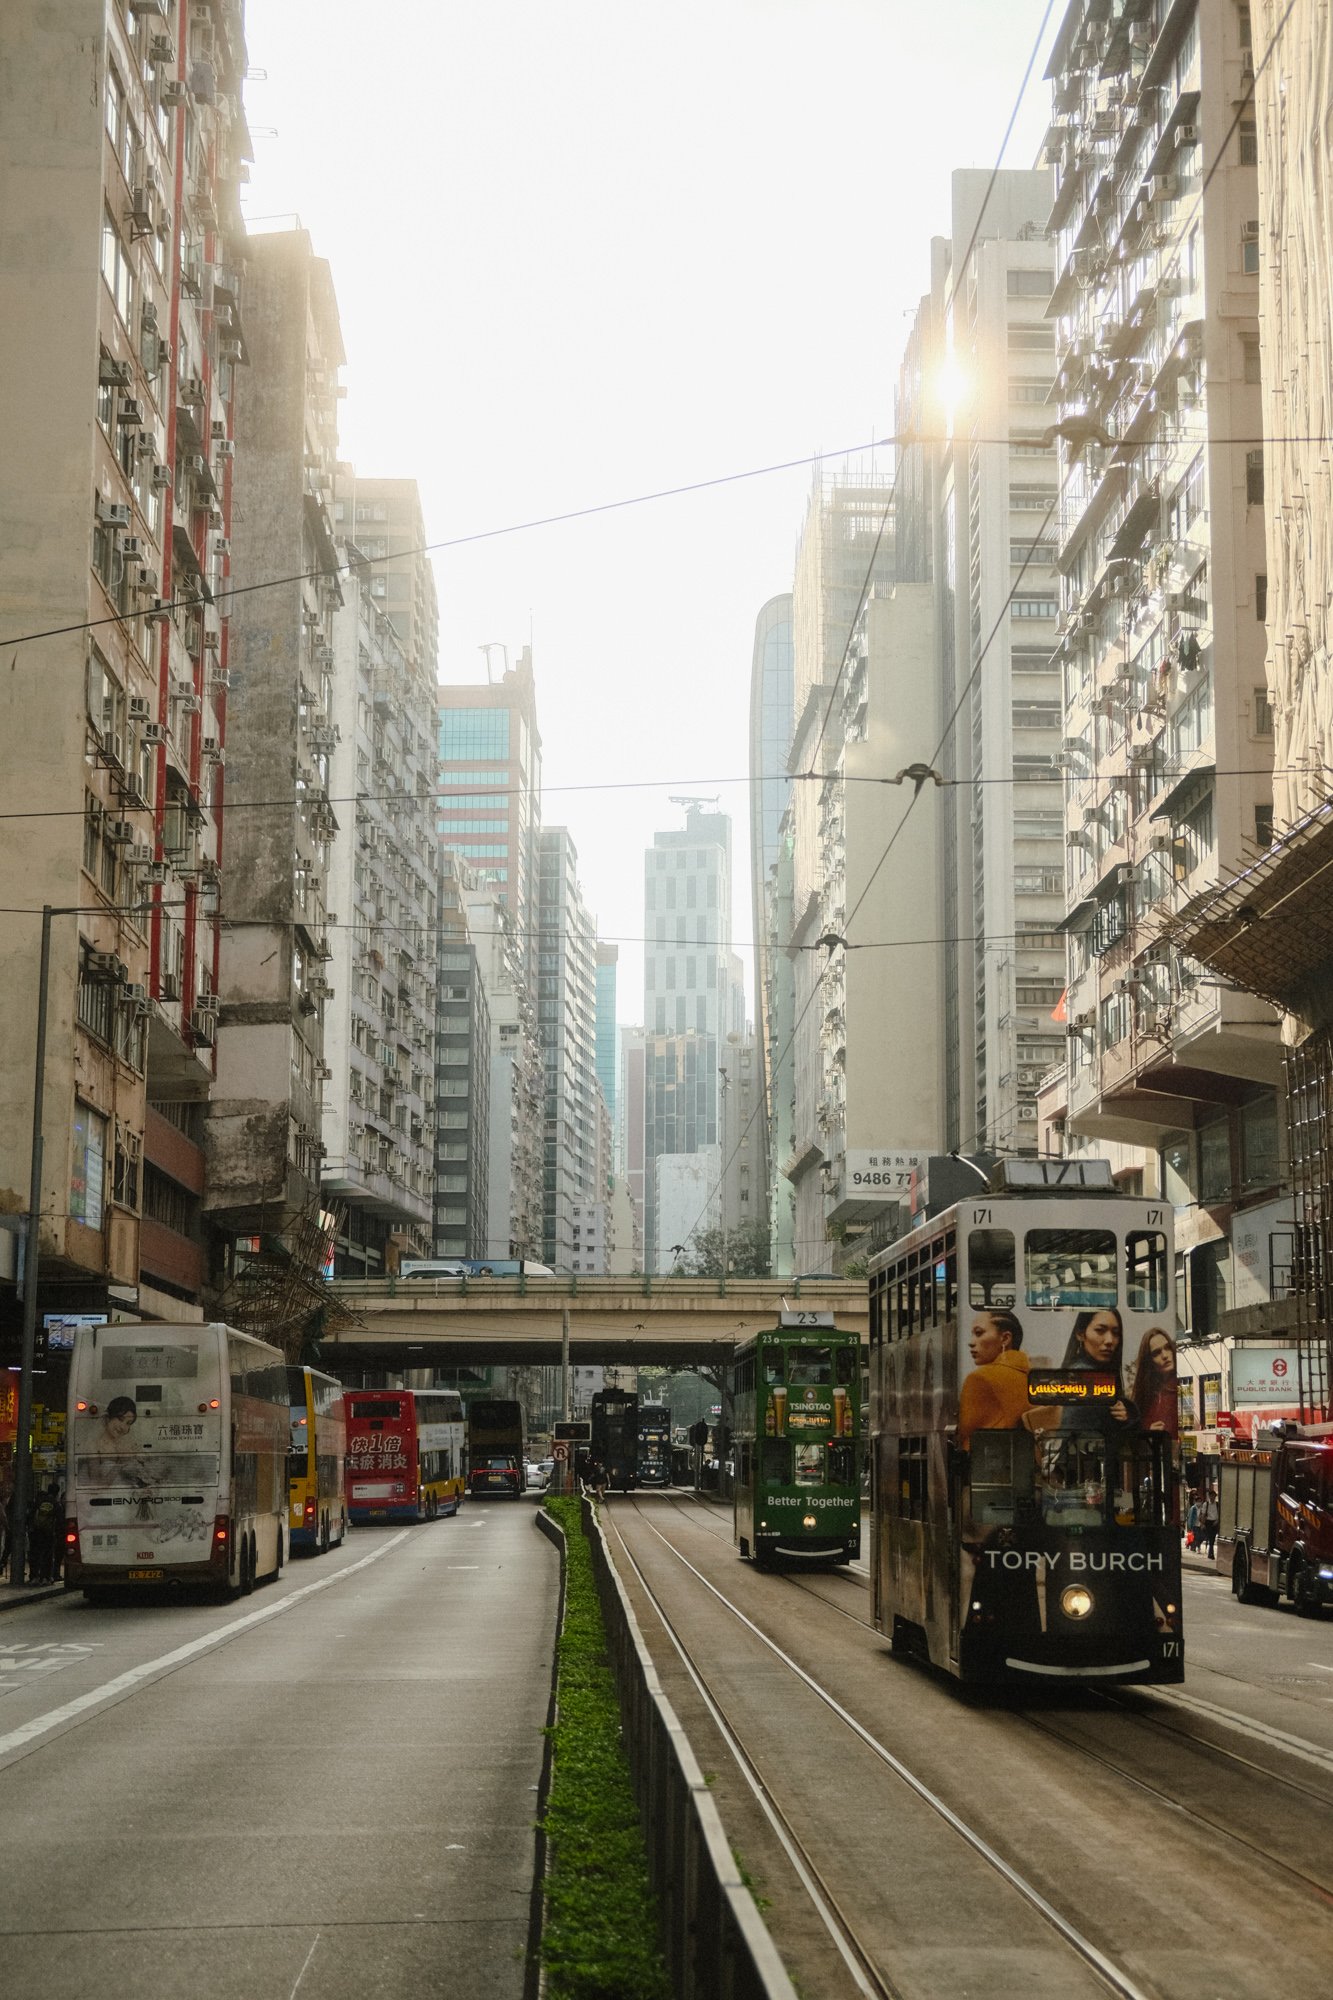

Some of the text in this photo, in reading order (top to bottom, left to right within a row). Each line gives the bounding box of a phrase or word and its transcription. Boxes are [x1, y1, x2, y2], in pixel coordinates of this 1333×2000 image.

[853, 1172, 891, 1185] 9486
[1041, 1161, 1086, 1185] 171
[973, 1209, 991, 1224] 171
[1147, 1210, 1163, 1225] 171
[798, 1312, 818, 1324] 23
[762, 1335, 772, 1344] 23
[848, 1336, 858, 1345] 23
[1029, 1384, 1116, 1397] Causeway Bay
[789, 1402, 831, 1411] TSINGTAO
[350, 1433, 402, 1453] 快1倍
[767, 1496, 855, 1508] Better Together
[848, 1539, 857, 1548] 23
[136, 1551, 155, 1560] KMB
[984, 1550, 1163, 1571] TORY BURCH
[1163, 1641, 1179, 1658] 171
